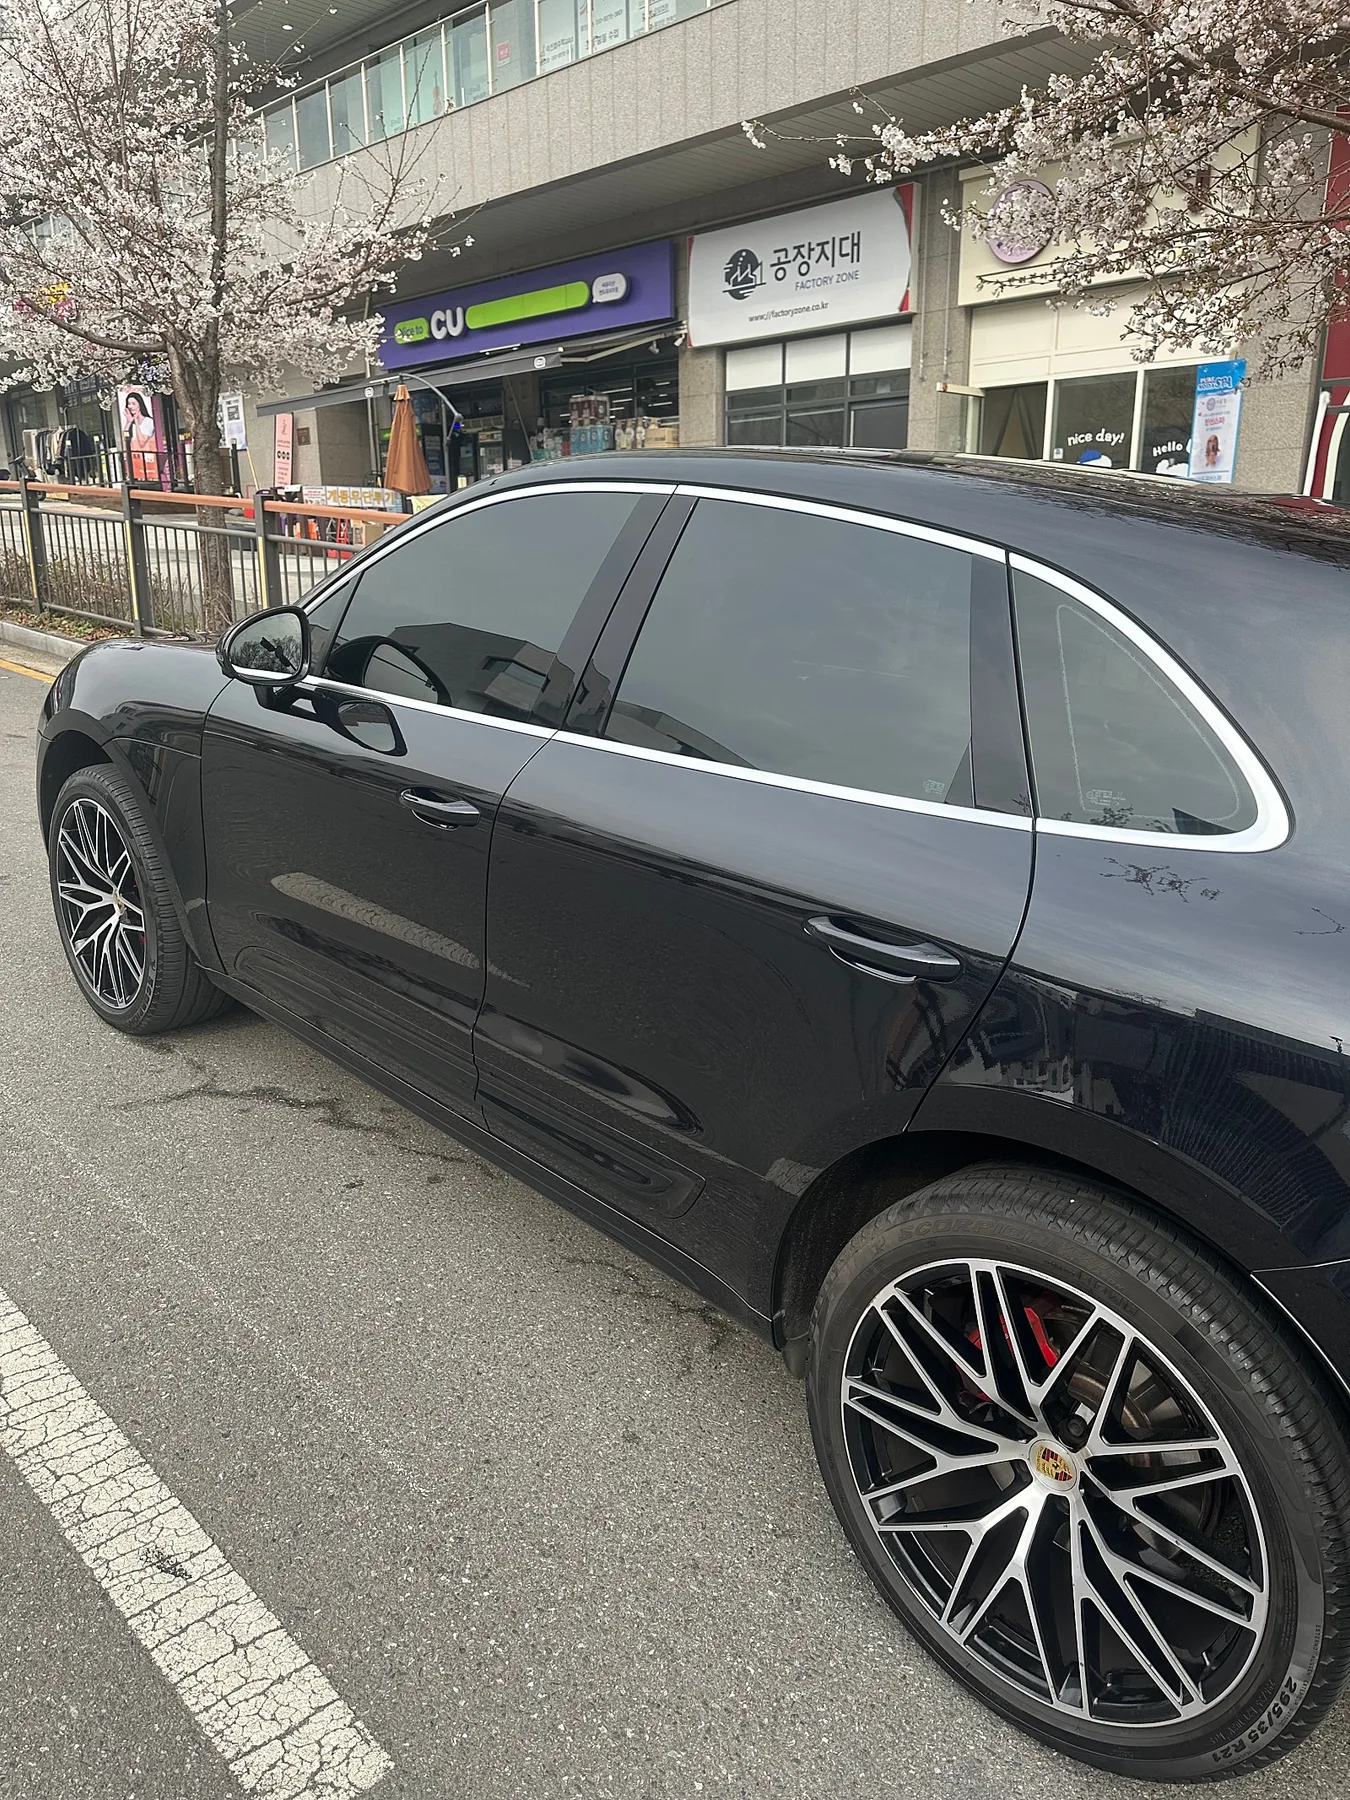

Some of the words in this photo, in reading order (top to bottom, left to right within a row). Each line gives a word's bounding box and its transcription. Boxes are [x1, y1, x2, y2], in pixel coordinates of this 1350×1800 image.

[769, 231, 861, 282] 공장지대
[795, 277, 833, 291] FACTORY
[836, 270, 860, 284] ZONE
[415, 325, 424, 335] to
[430, 306, 464, 340] CU
[1067, 432, 1093, 447] nice
[1095, 428, 1125, 446] day!
[1152, 440, 1183, 457] Hello
[898, 1218, 1054, 1249] SCORPION
[1247, 1676, 1298, 1744] 295/35
[1212, 1738, 1247, 1763] R21
